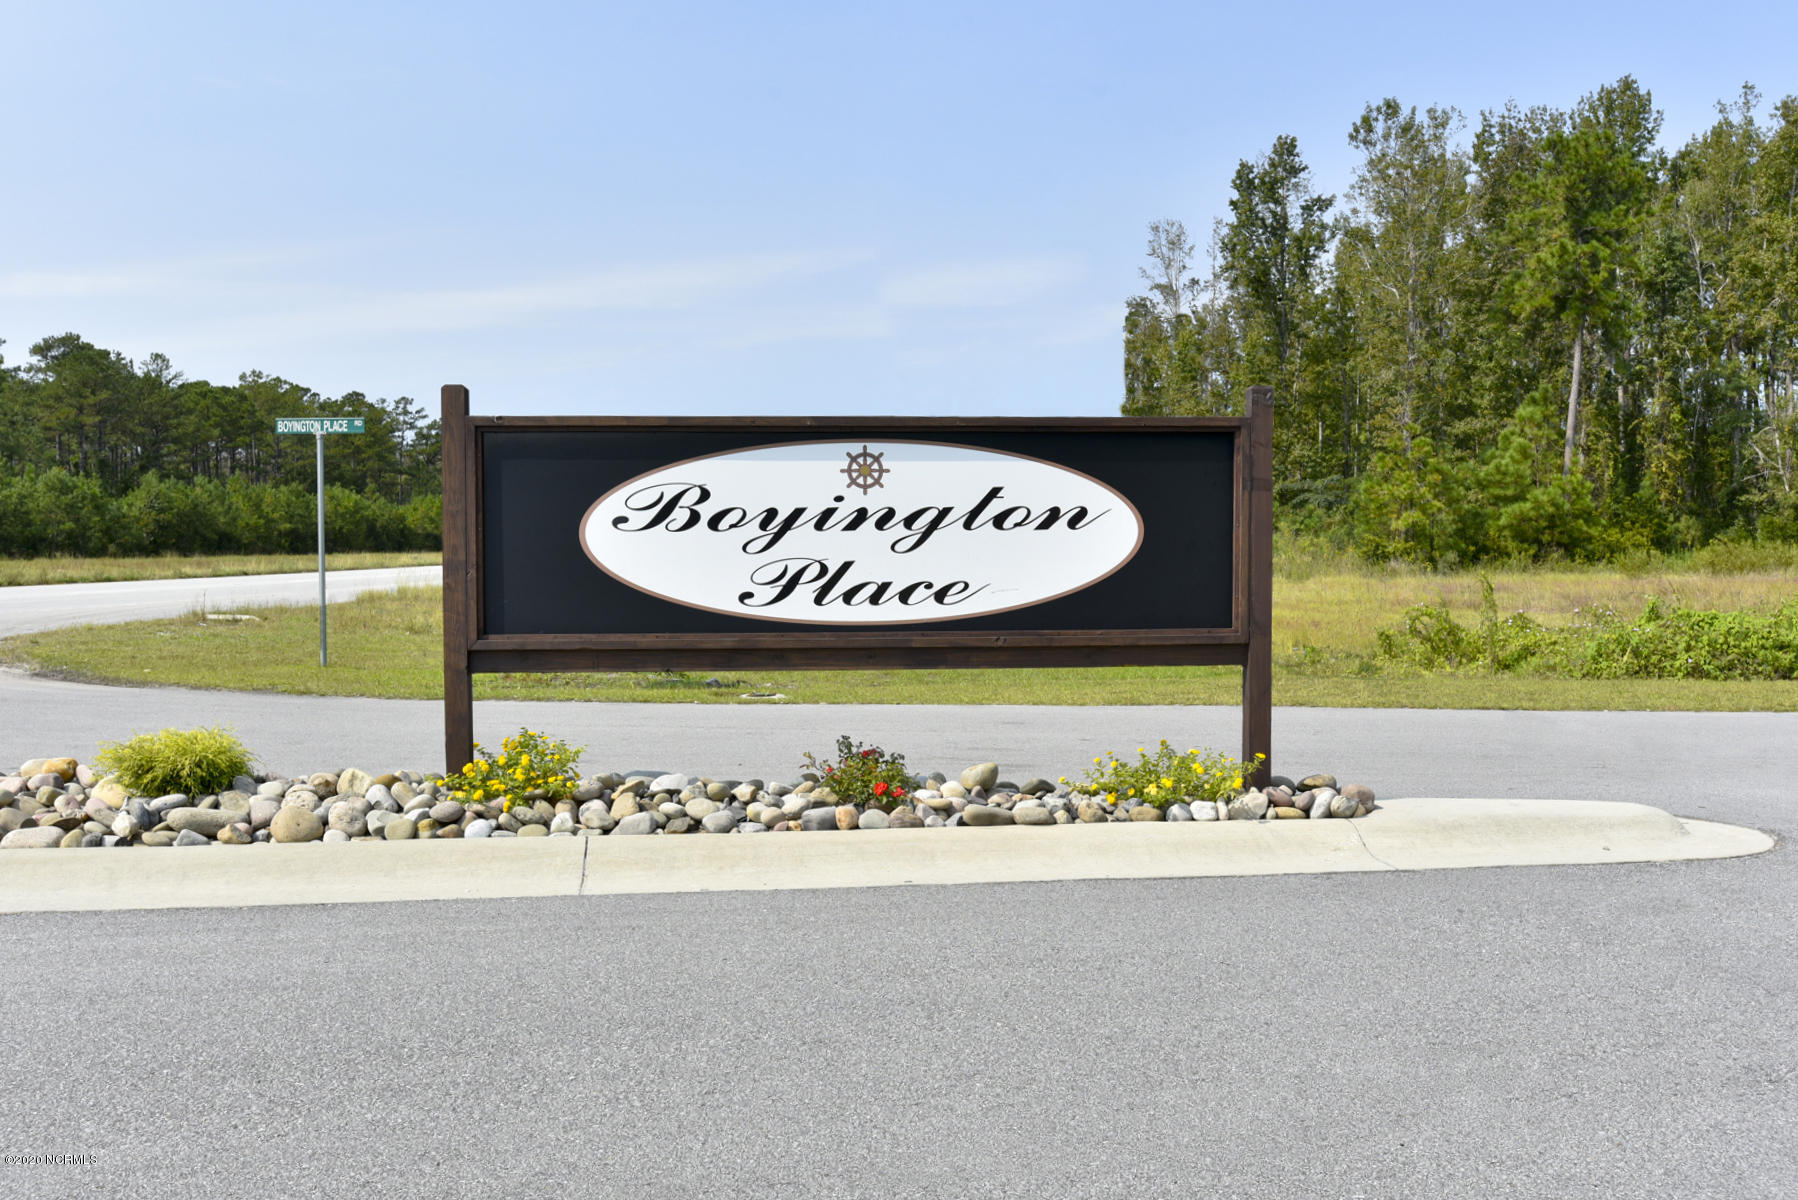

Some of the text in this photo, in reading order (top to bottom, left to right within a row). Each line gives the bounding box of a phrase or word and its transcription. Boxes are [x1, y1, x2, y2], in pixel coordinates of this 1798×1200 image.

[277, 421, 321, 433] BOYINGTON
[323, 420, 348, 432] PLACE
[611, 482, 1112, 555] Boyington
[738, 557, 991, 608] Place
